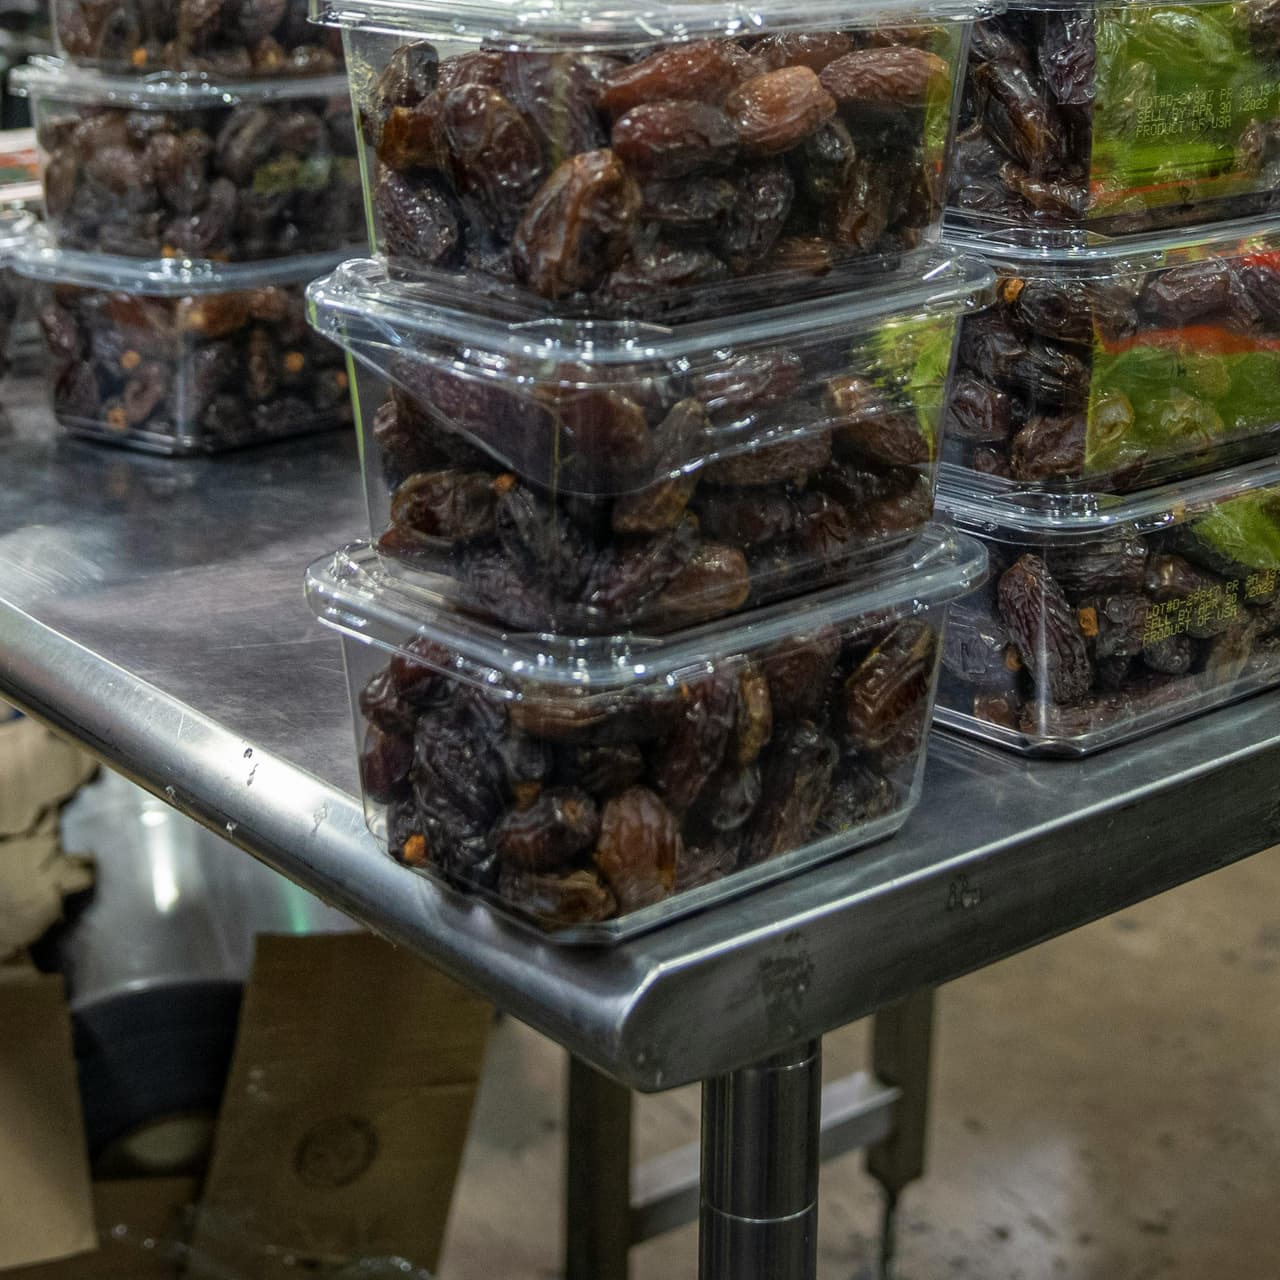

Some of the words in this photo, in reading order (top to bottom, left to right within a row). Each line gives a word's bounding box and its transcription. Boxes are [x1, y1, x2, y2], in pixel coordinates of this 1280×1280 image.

[1220, 87, 1233, 101] PR
[1136, 110, 1165, 123] SELL
[1220, 102, 1232, 114] 30
[1136, 121, 1185, 137] PRODUCT
[1191, 119, 1204, 131] OF
[1212, 117, 1232, 129] USA
[1226, 579, 1239, 593] PR
[1144, 615, 1170, 632] SELL
[1225, 593, 1238, 605] 30
[1142, 620, 1191, 647] PRODUCT
[1198, 614, 1210, 627] OF
[1216, 606, 1238, 620] USA
